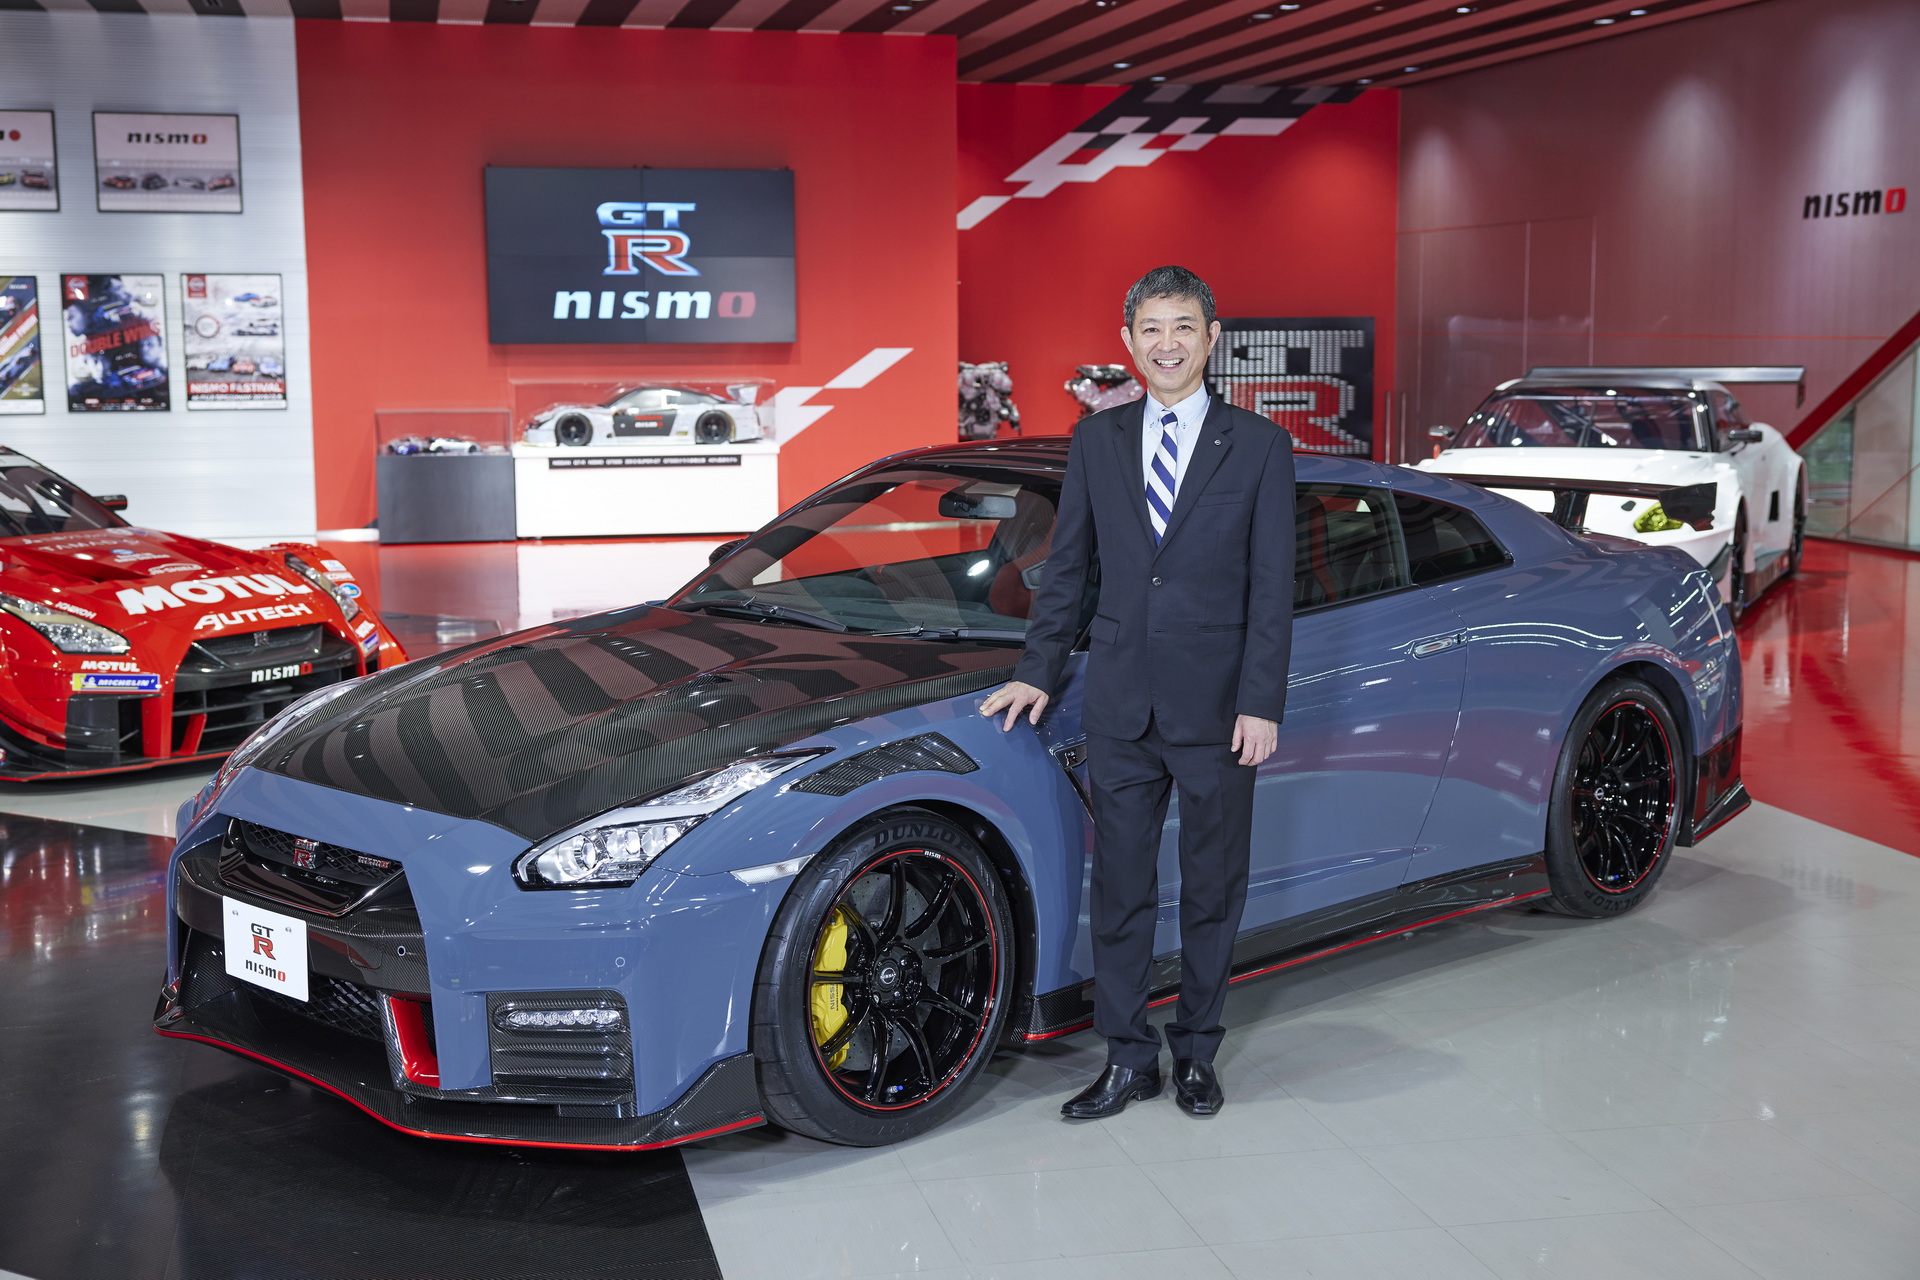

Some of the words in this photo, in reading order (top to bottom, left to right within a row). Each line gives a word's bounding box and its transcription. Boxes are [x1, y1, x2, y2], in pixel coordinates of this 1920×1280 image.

[127, 132, 208, 145] nismo
[596, 202, 696, 228] GT
[1802, 187, 1907, 219] nismo
[601, 230, 701, 276] R
[553, 291, 756, 319] nismo
[1209, 330, 1365, 375] GT
[115, 573, 314, 616] MOTUL
[193, 602, 314, 631] AUTECH
[80, 660, 141, 673] MOTUL
[251, 662, 313, 684] nismo
[97, 678, 151, 687] MICHELIN
[873, 822, 975, 850] DUNLOP
[292, 848, 316, 870] R
[923, 850, 946, 861] nismo
[250, 922, 274, 939] GT
[252, 933, 277, 961] R
[245, 959, 287, 983] nismo
